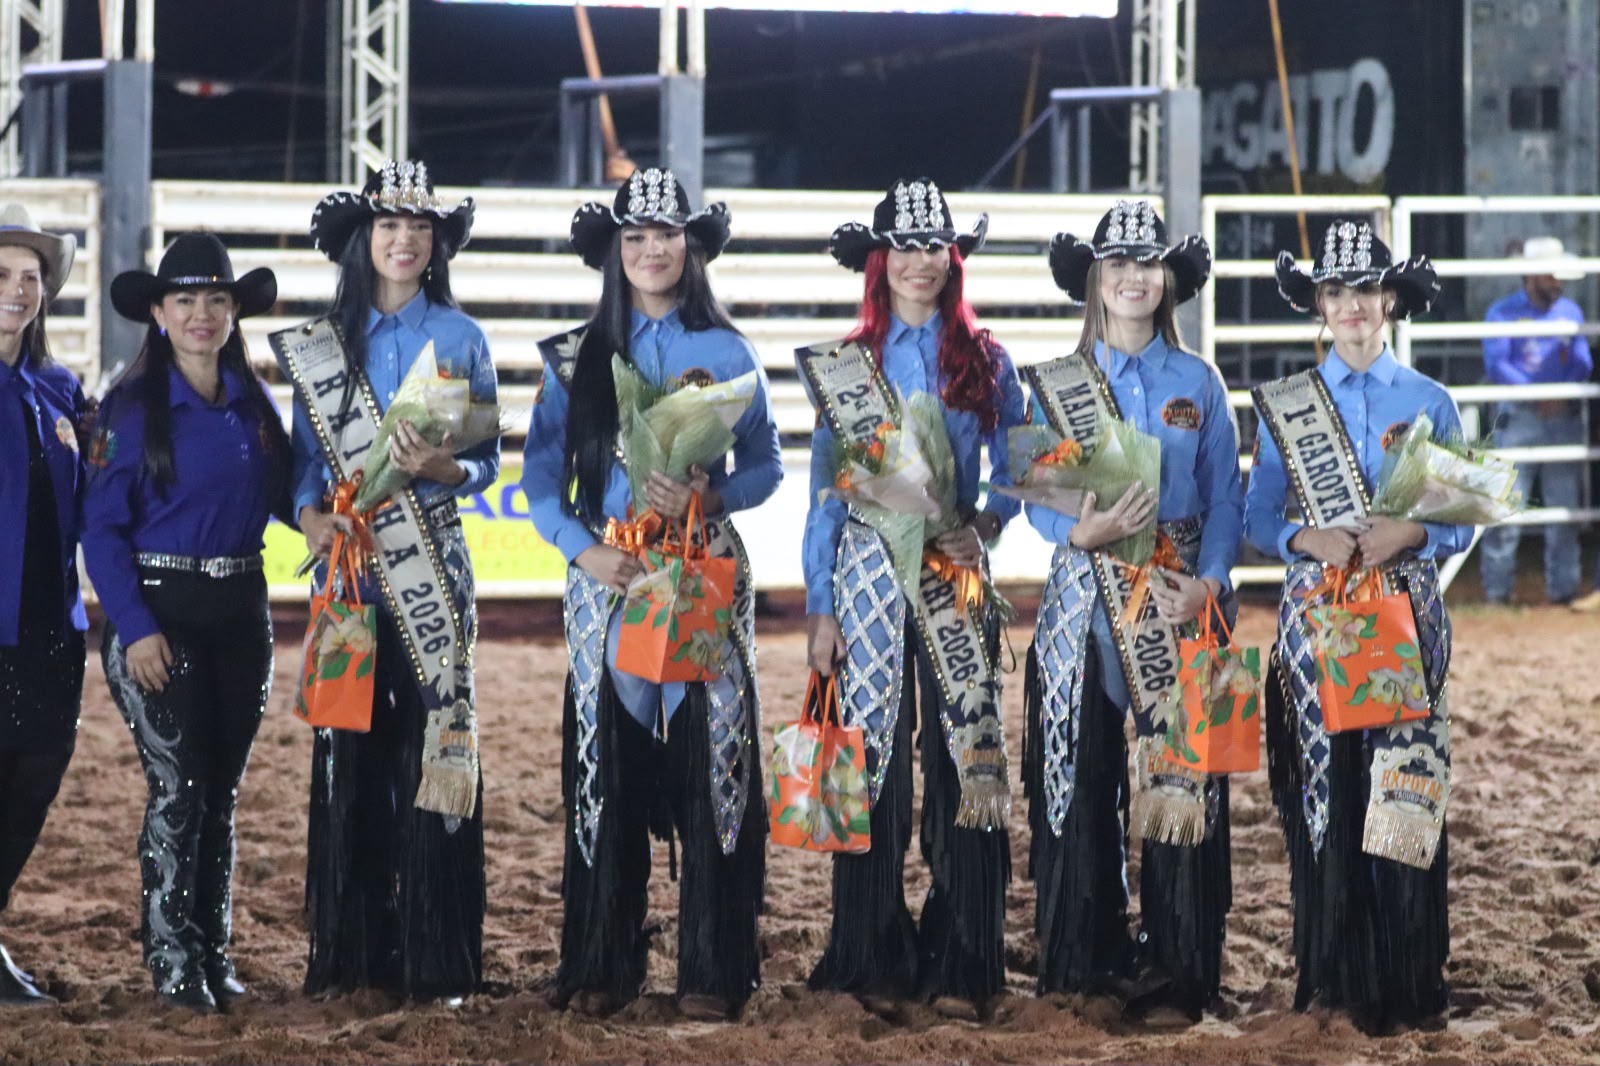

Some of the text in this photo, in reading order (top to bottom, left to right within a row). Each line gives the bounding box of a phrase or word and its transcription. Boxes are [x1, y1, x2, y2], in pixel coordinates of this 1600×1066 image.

[1295, 431, 1356, 524] GAROTA
[401, 581, 451, 654] 2026
[937, 618, 980, 683] 2026
[1133, 628, 1177, 692] 2026
